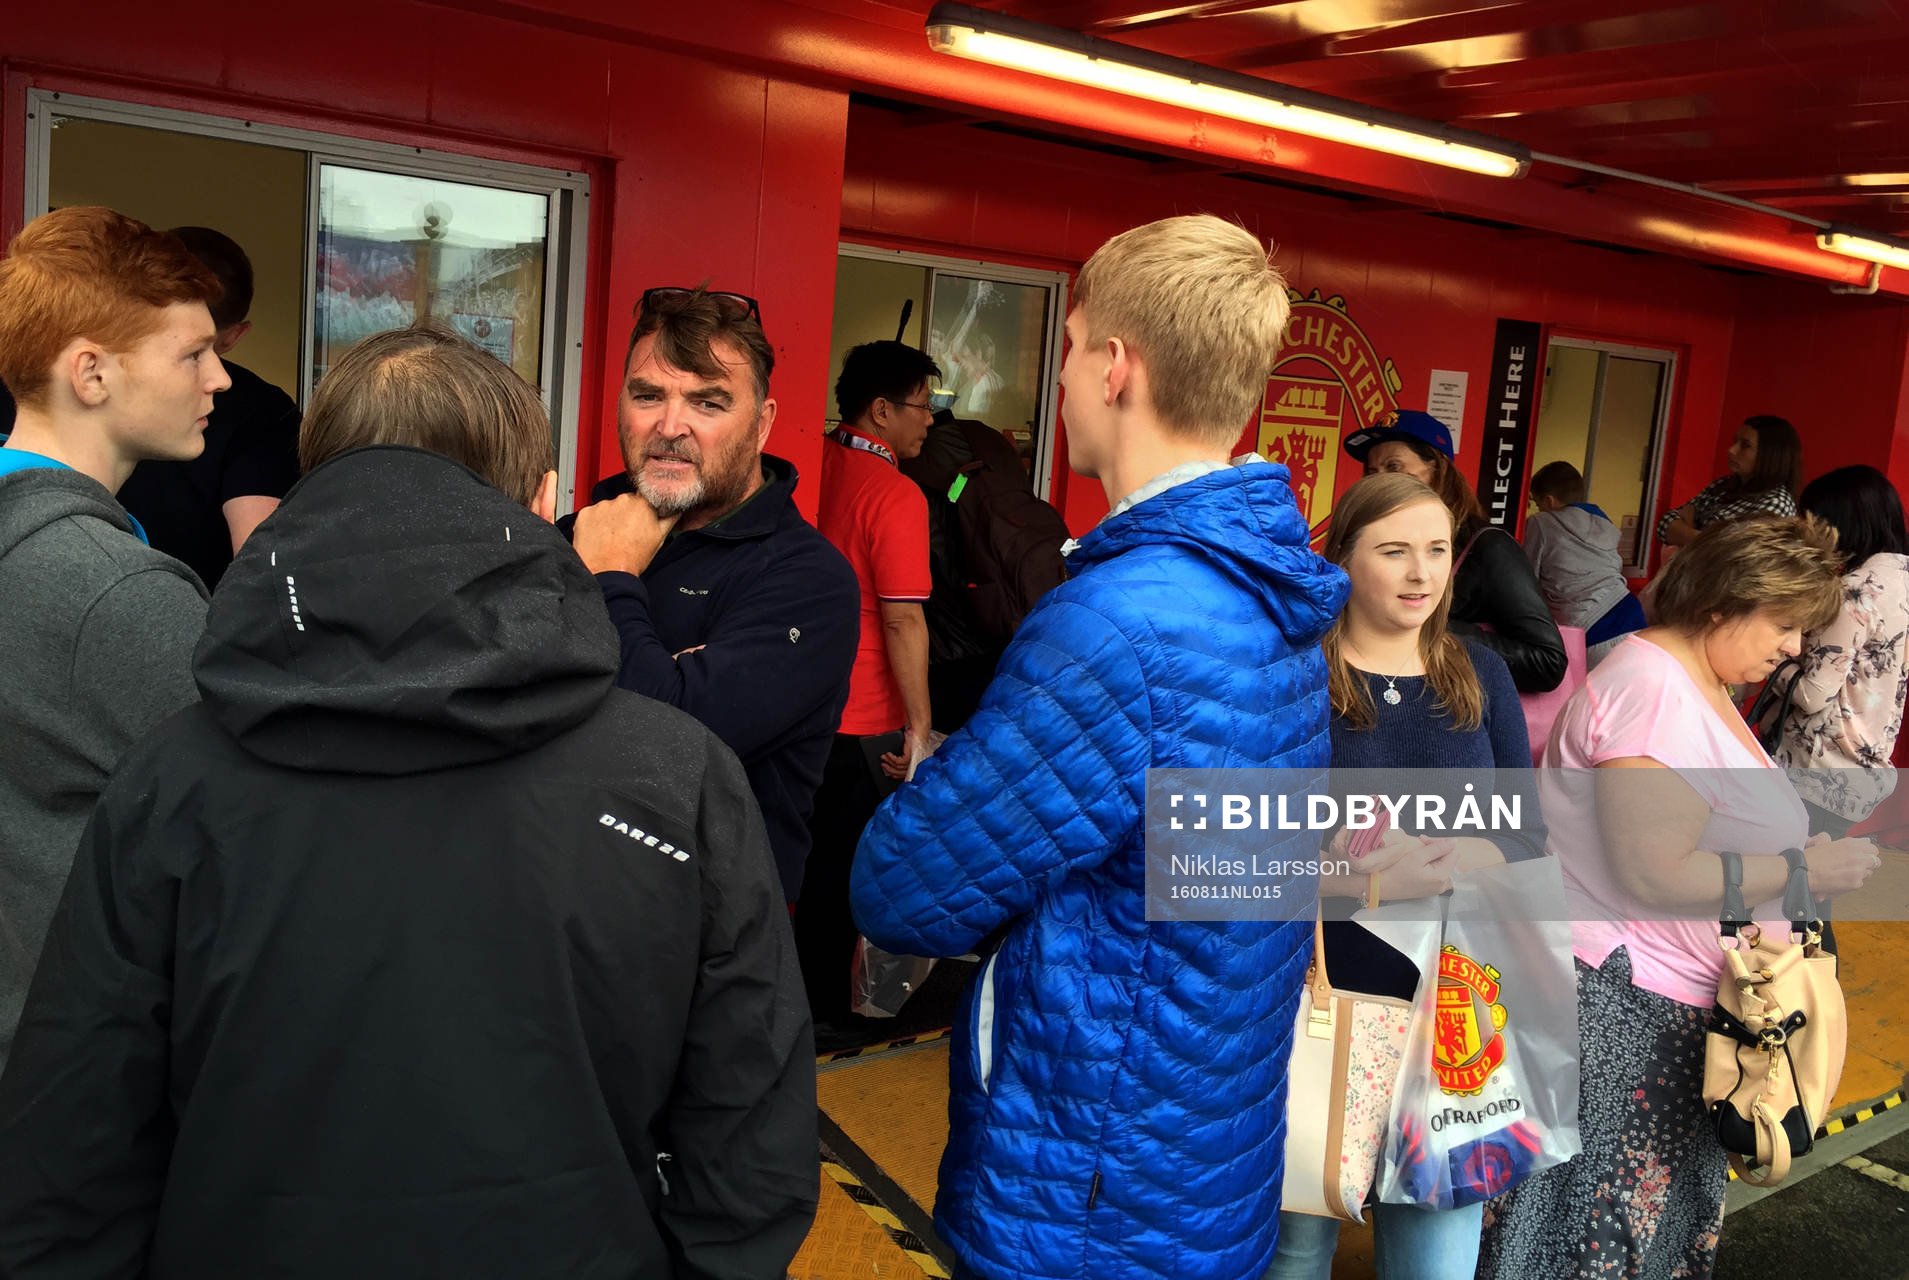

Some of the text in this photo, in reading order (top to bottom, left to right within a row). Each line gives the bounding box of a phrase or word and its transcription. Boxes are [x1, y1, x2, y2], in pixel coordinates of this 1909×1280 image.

[1282, 315, 1385, 423] CHESTER
[1490, 345, 1526, 525] LLECT HERE
[1438, 1055, 1491, 1086] NITED
